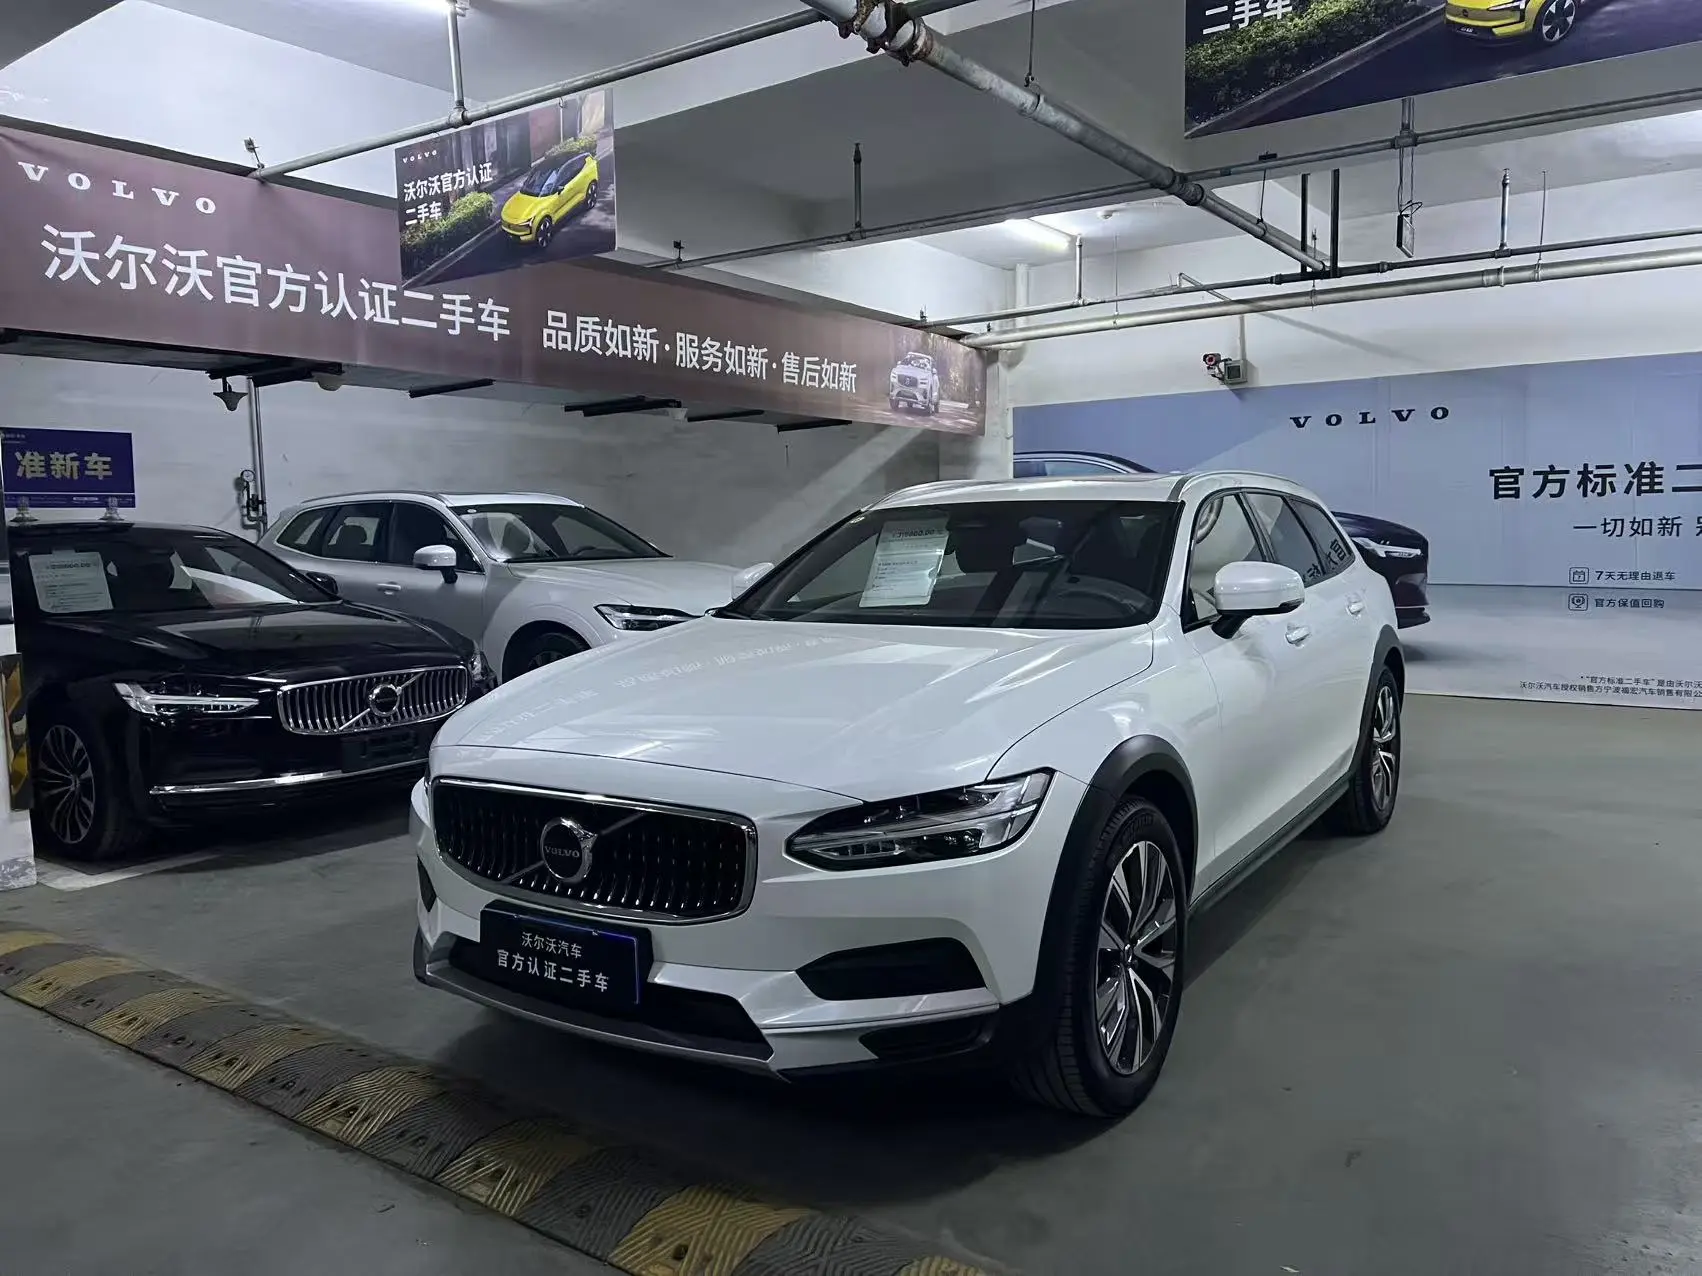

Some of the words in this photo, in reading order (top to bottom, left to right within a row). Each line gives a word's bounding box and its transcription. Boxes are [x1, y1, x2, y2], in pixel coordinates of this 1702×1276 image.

[402, 149, 438, 164] VOLVO
[17, 160, 217, 215] VOLVO
[403, 162, 494, 202] 沃尔沃官方认证
[404, 201, 443, 226] 二手车
[40, 223, 511, 342] 沃尔沃官方认证二手车
[1290, 406, 1450, 429] VOLVO
[14, 450, 113, 480] 准新车
[1489, 460, 1702, 500] 官方标准二
[1573, 515, 1683, 538] 一切如新
[1595, 570, 1677, 581] 7天无理由退车
[1594, 598, 1665, 608] 官方保值回购
[544, 845, 581, 858] VOLVO
[521, 931, 583, 959] 沃尔沃汽车
[496, 949, 609, 992] 官方认证二手车
